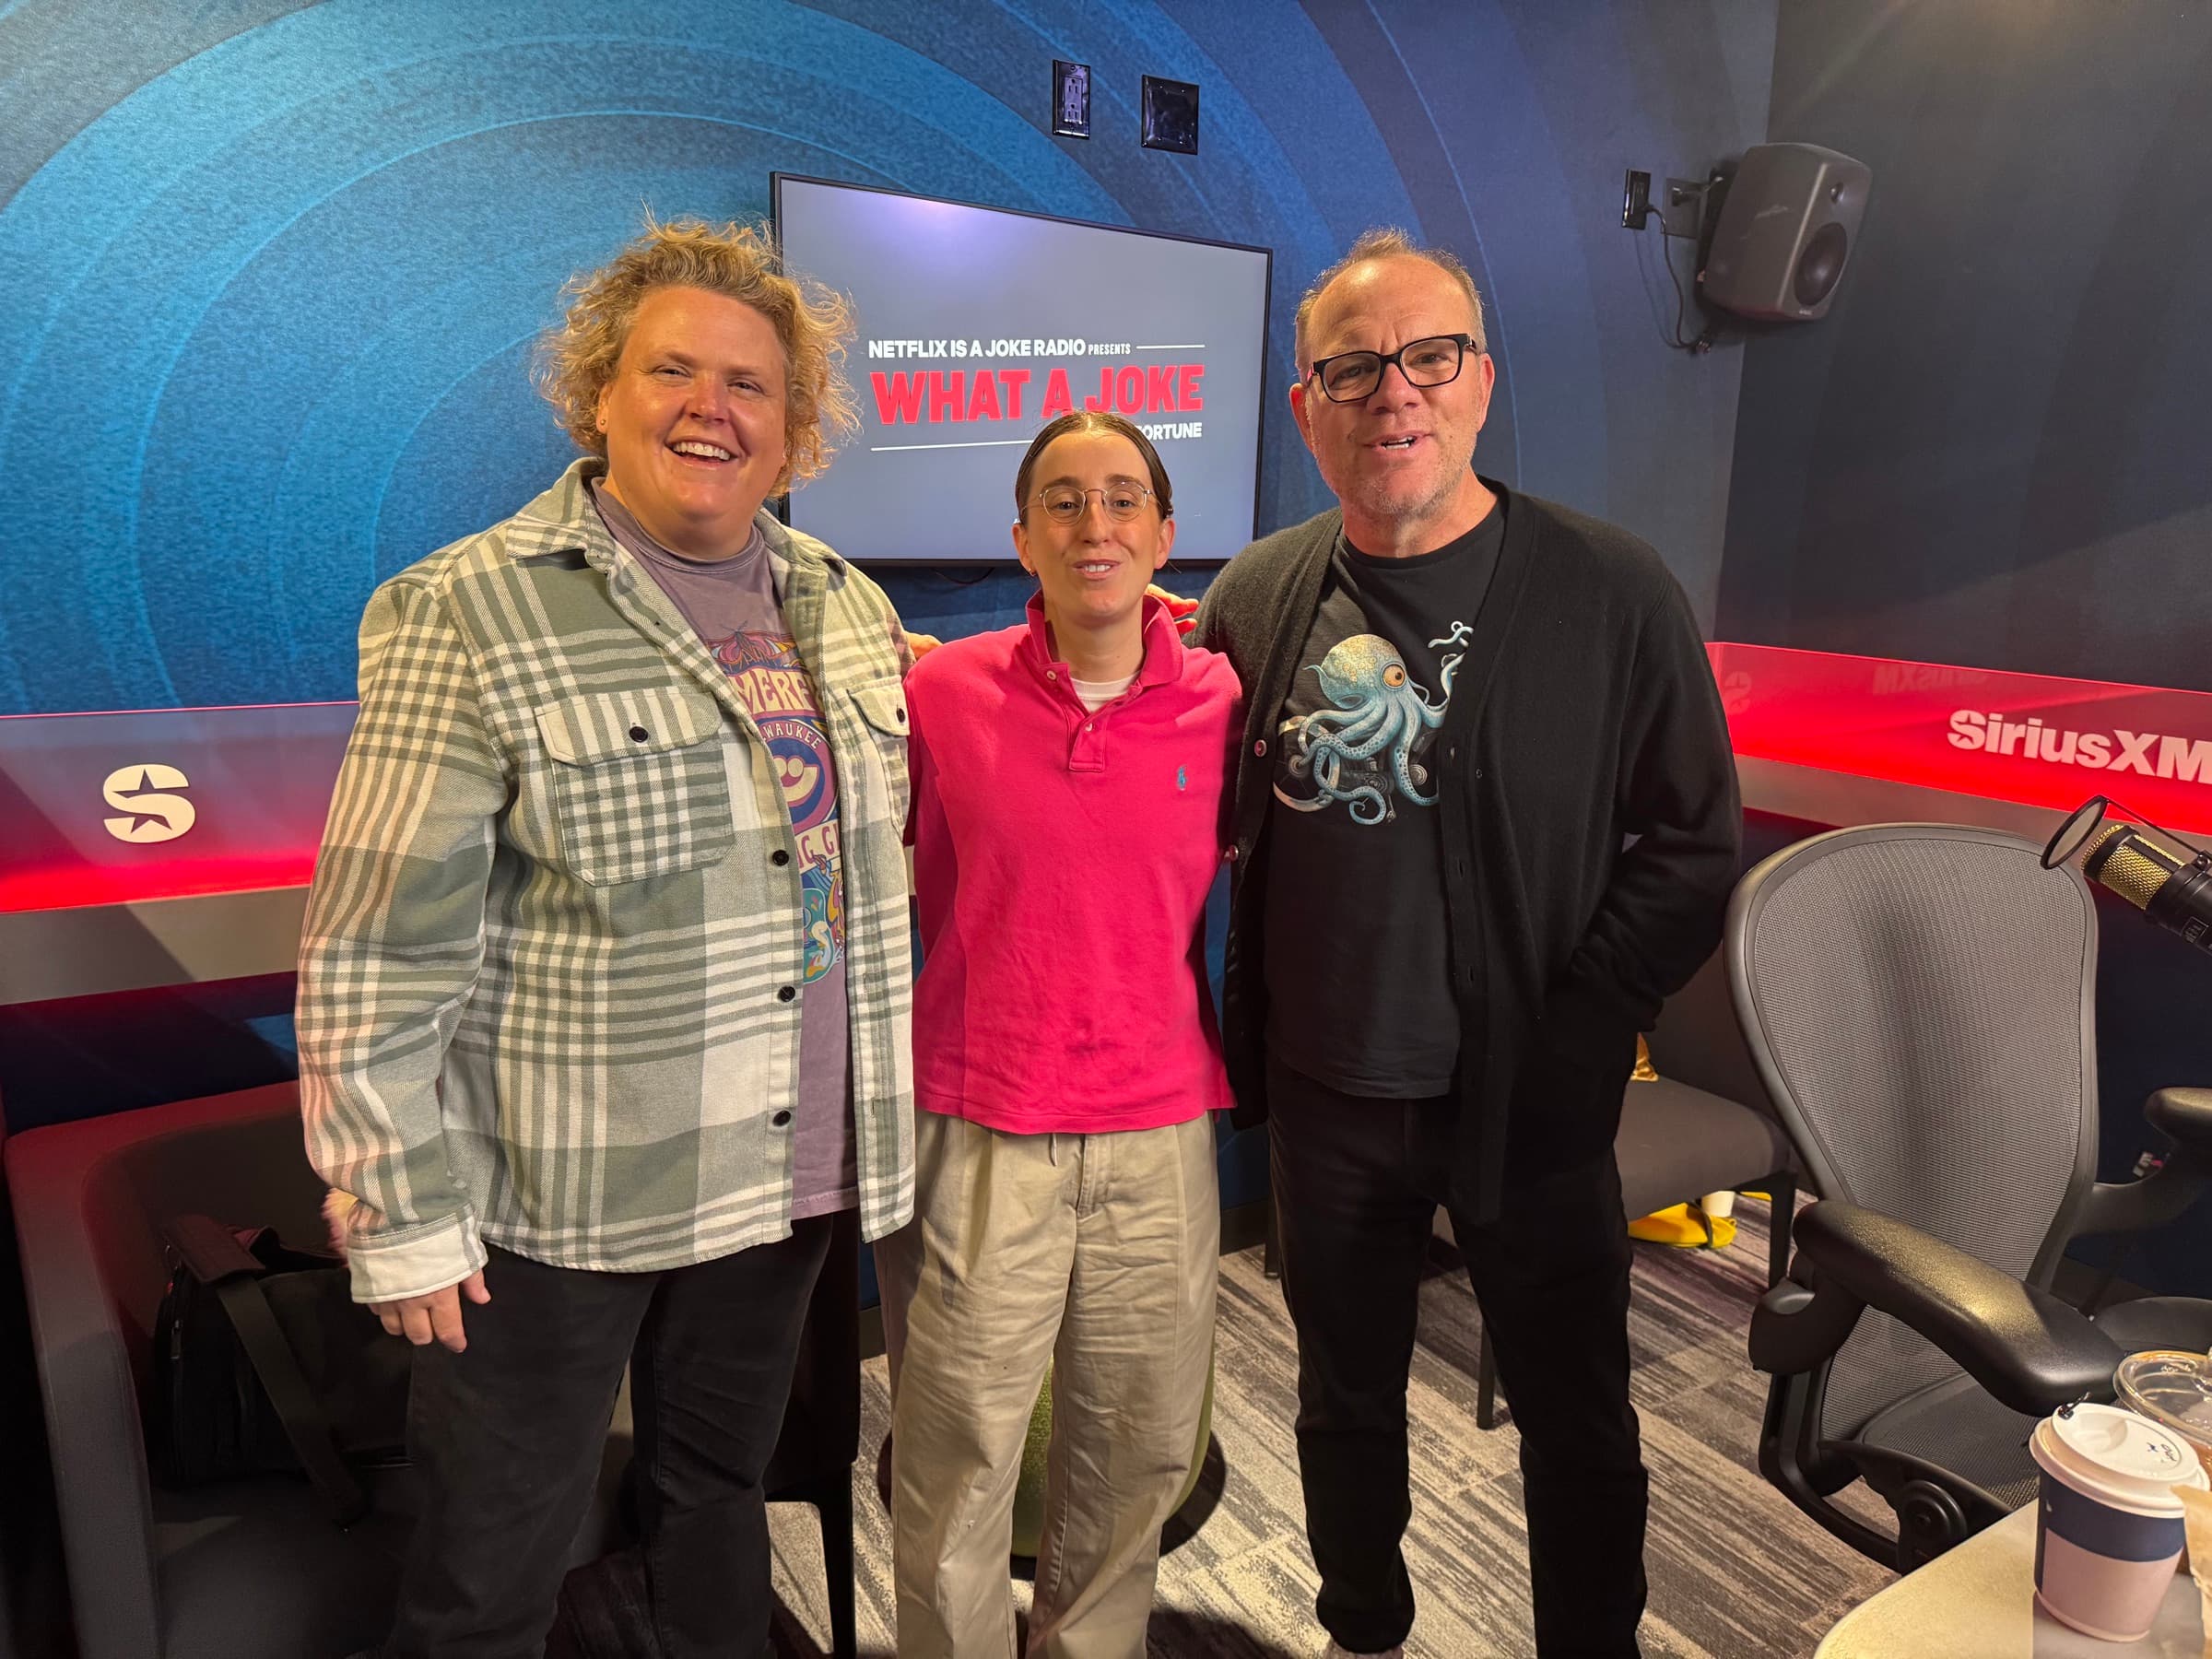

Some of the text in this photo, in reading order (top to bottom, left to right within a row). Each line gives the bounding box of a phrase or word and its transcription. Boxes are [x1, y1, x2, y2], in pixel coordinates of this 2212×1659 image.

[869, 339, 1131, 359] NETFLIX IS A JOKE RADIO PRESENTS
[870, 364, 1205, 424] WHAT A JOKE
[1947, 710, 2212, 784] SiriusXM
